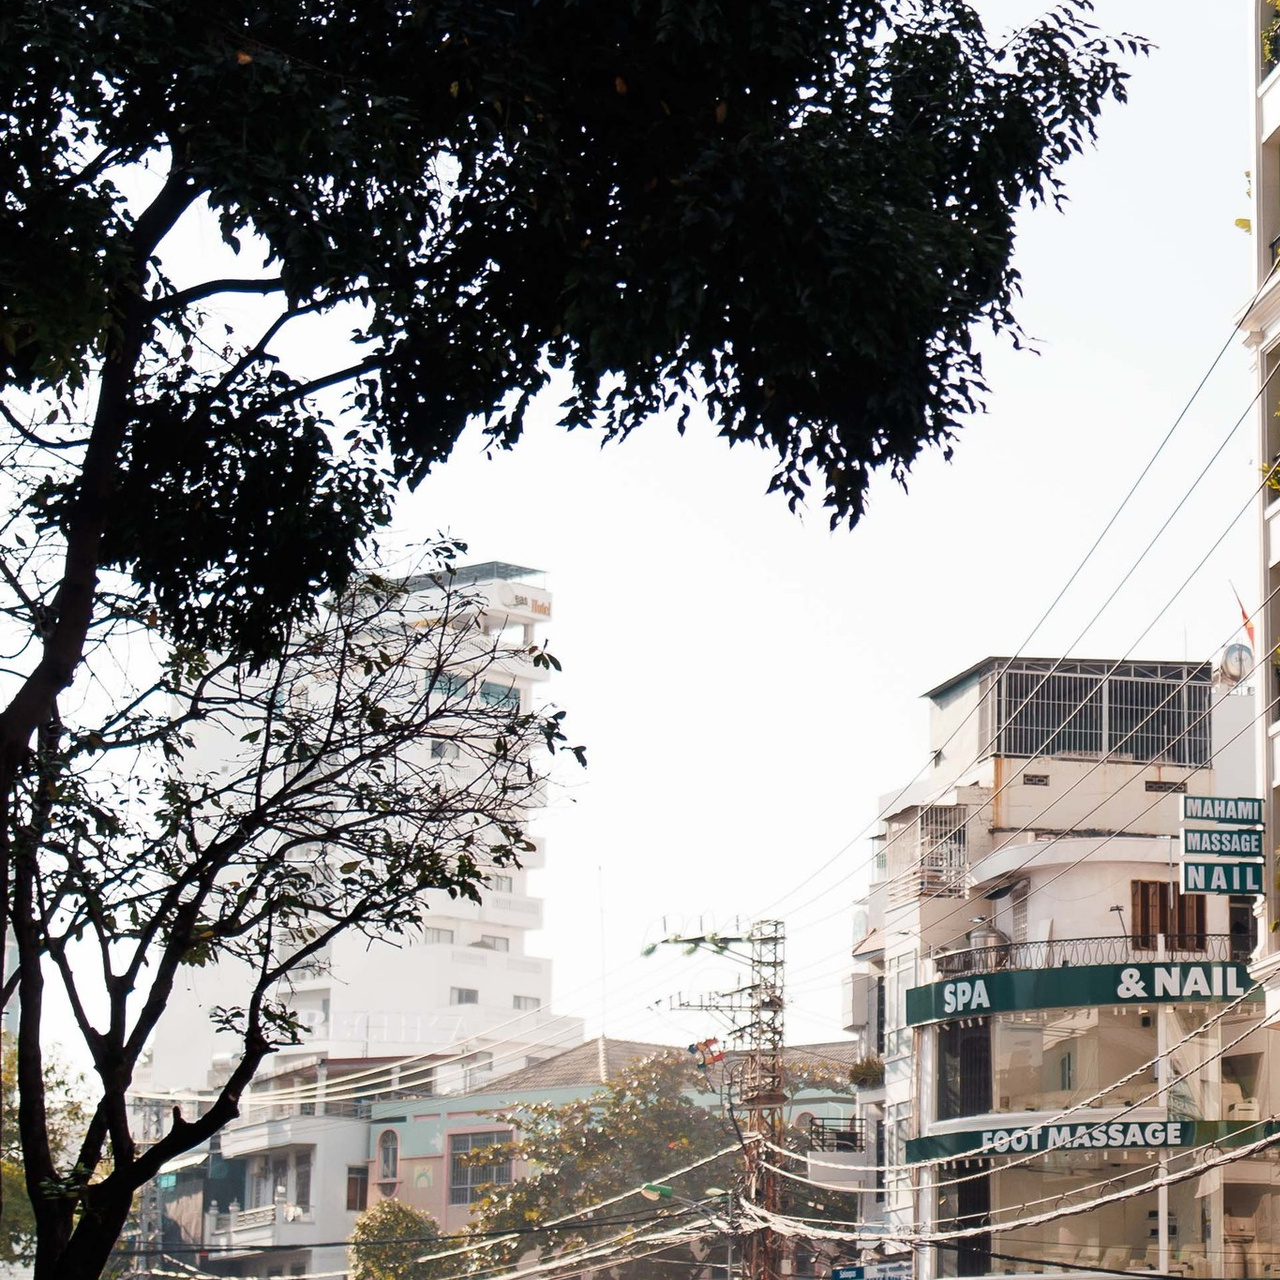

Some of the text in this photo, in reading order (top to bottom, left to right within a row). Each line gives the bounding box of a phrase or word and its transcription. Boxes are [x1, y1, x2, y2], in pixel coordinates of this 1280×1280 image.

[1186, 798, 1259, 820] MAHAMI
[1187, 833, 1260, 852] MASSAGE
[1188, 865, 1260, 890] NAIL
[944, 966, 1245, 1013] SPA & NAIL
[982, 1122, 1182, 1155] FOOT MASSAGE
